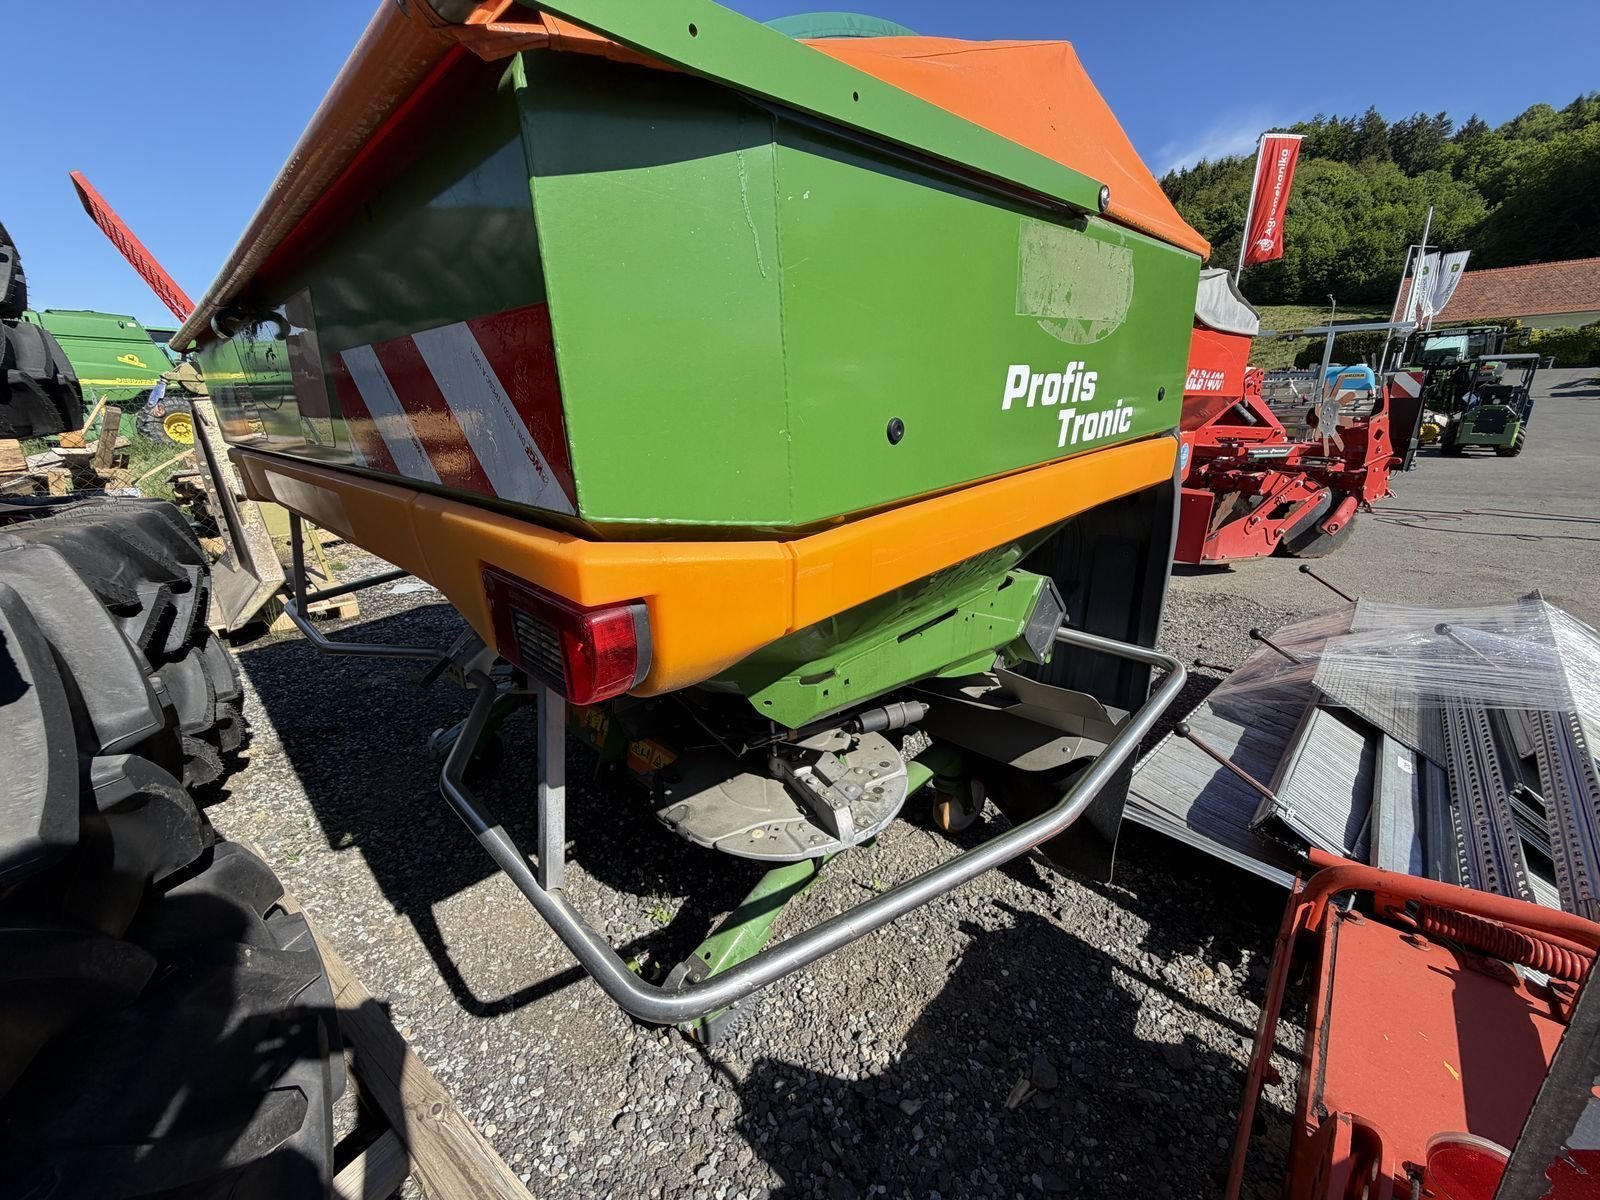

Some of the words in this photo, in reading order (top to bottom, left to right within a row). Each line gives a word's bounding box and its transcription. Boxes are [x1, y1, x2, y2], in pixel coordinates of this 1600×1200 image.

[1265, 148, 1289, 237] Agromehanika
[1001, 361, 1098, 411] Profis
[1057, 398, 1134, 448] Tronic
